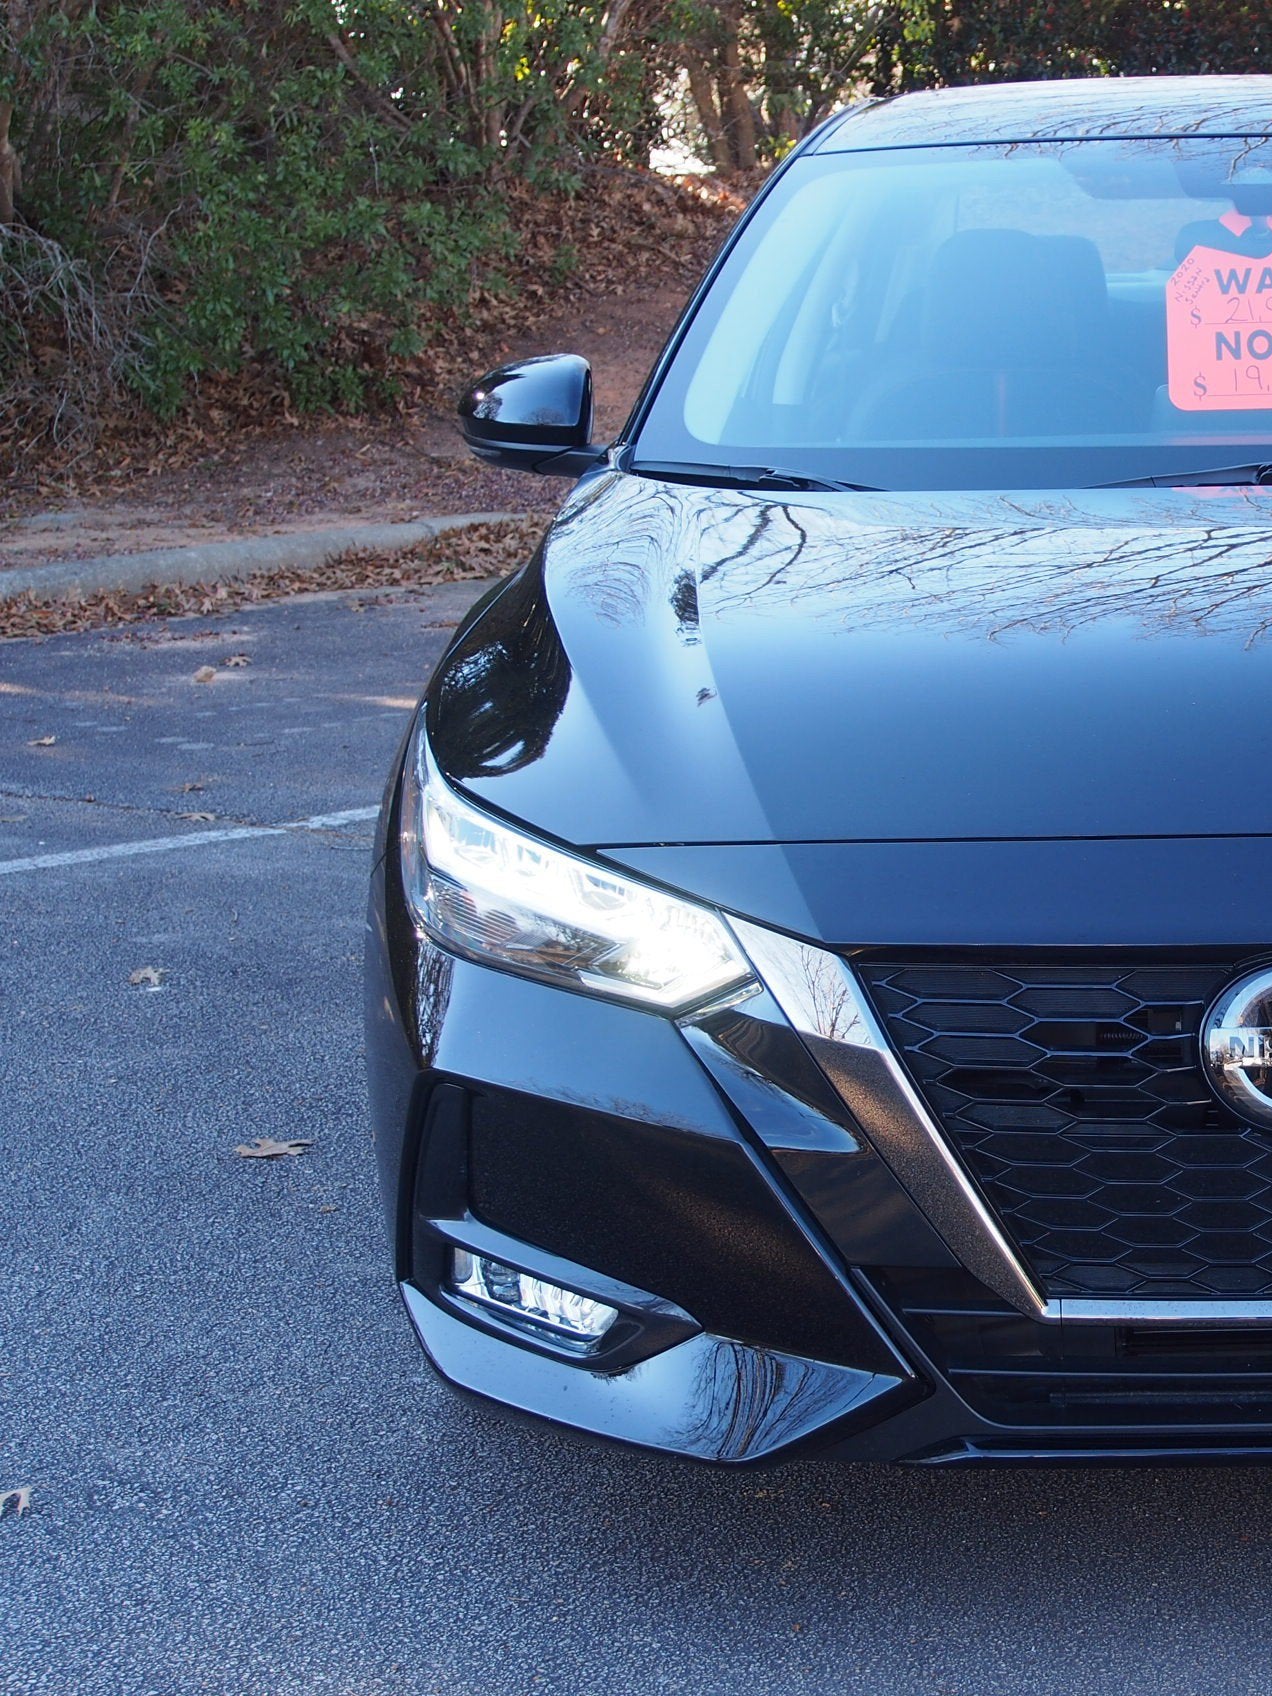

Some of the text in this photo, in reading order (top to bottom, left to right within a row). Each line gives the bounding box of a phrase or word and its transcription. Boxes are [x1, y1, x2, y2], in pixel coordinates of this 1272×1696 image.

[1171, 258, 1195, 286] 2020
[1190, 306, 1202, 328] $
[1193, 372, 1207, 400] $
